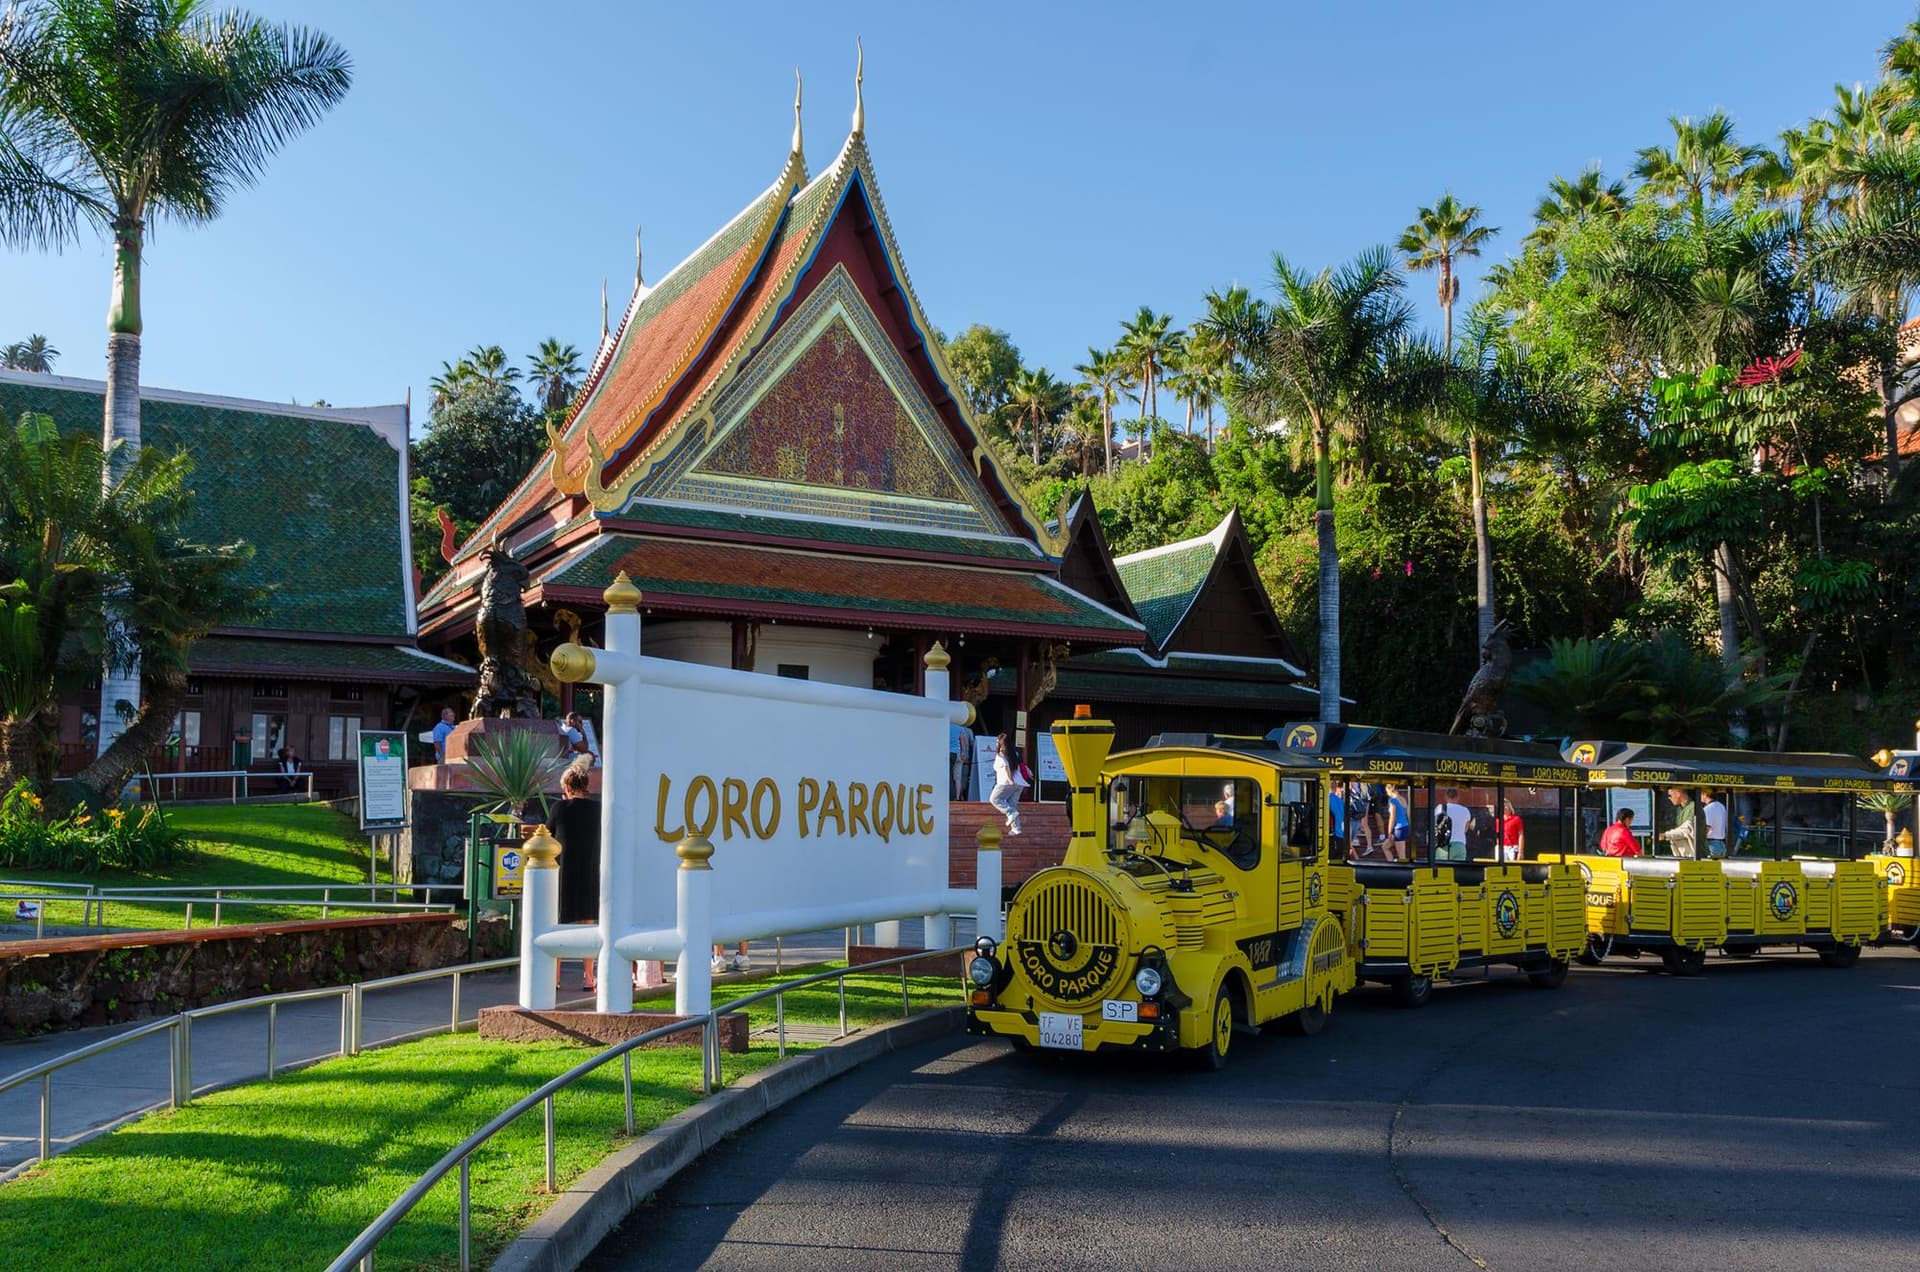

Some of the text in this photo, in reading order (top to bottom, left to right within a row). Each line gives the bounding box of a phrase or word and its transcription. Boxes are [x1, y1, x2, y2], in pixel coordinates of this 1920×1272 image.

[1369, 760, 1404, 772] SHOW
[1436, 759, 1458, 773] LORO
[1459, 761, 1489, 775] PARQUE
[1532, 767, 1552, 780] LORO
[1632, 770, 1670, 782] SHOW
[1692, 773, 1745, 785] LORO PARQUE
[654, 773, 934, 843] LORO PARQUE
[1249, 940, 1272, 964] 1887
[1023, 947, 1113, 994] LORO PARQUE
[1042, 1016, 1080, 1030] TF VE
[1044, 1032, 1079, 1046] 04280
